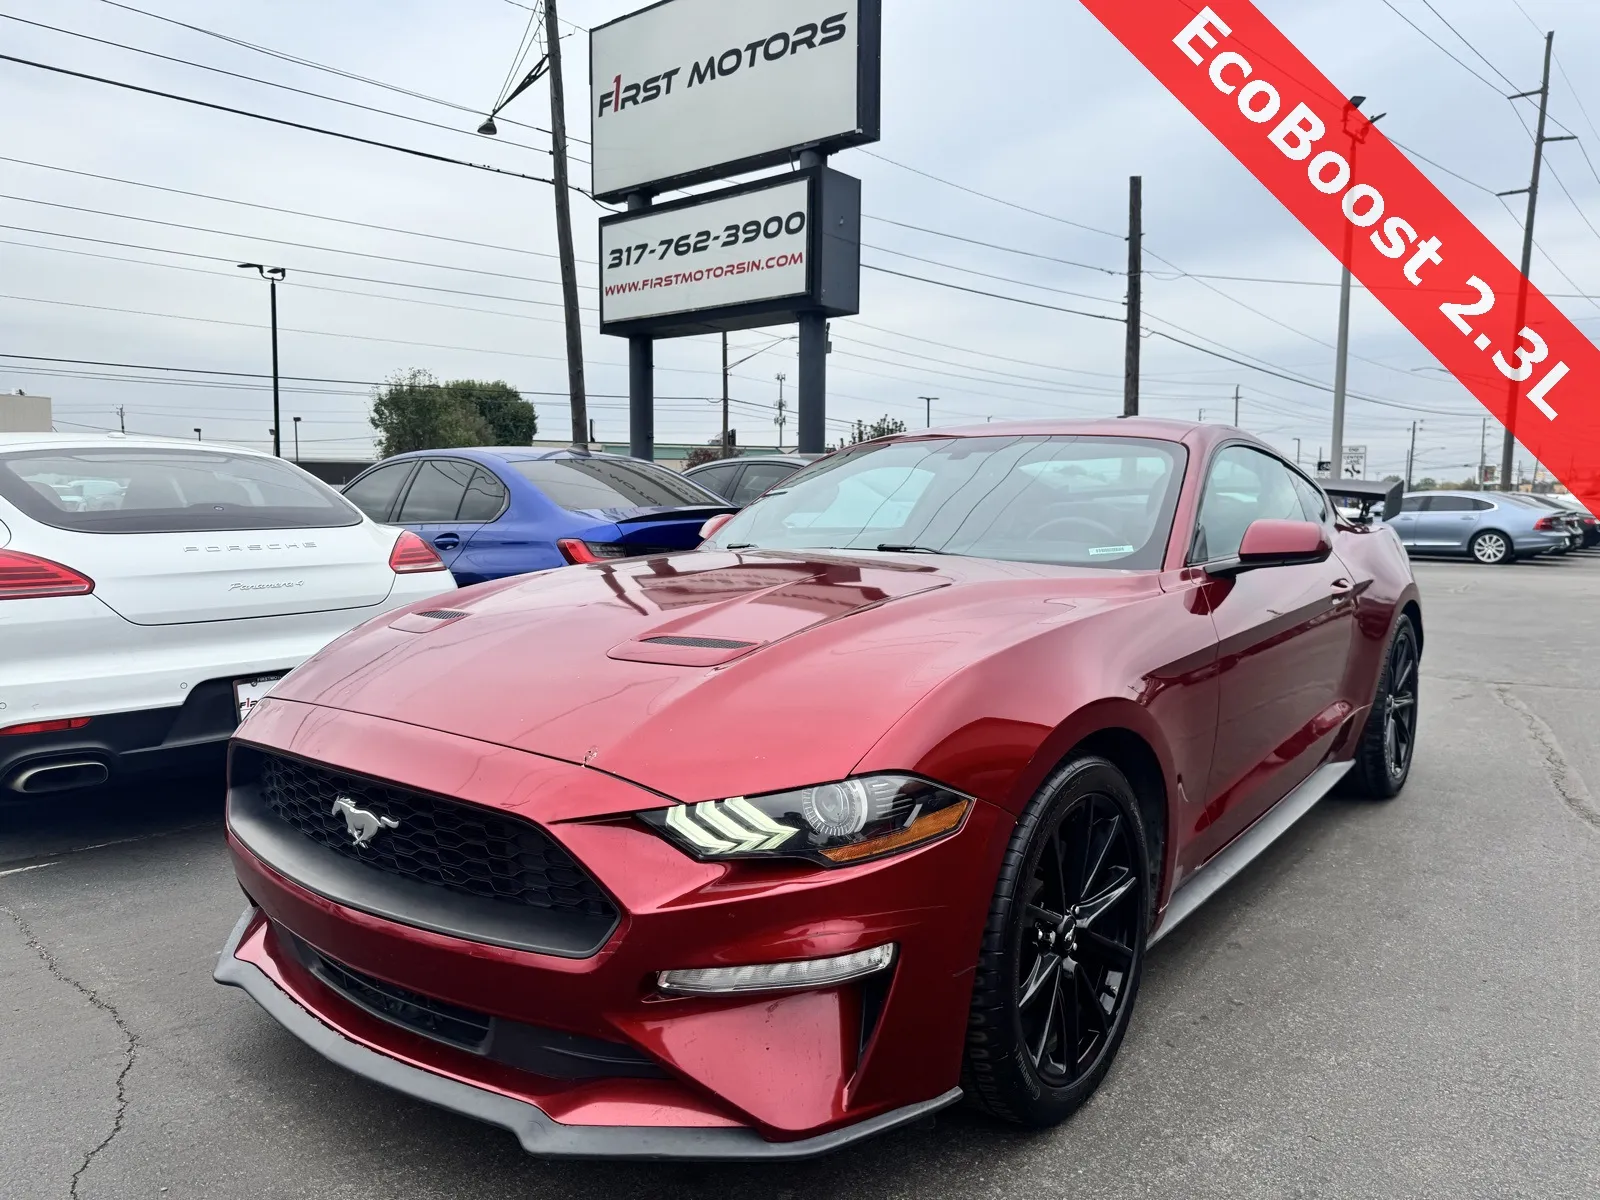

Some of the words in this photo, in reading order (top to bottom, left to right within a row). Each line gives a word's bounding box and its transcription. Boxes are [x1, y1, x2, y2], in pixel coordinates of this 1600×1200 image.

[687, 12, 848, 88] MOTORS
[607, 211, 806, 270] 317-762-3900
[604, 252, 804, 297] WWW.FIRSTMOTORSIN.COM
[183, 541, 318, 553] PORSCHE
[228, 582, 294, 592] Panamera
